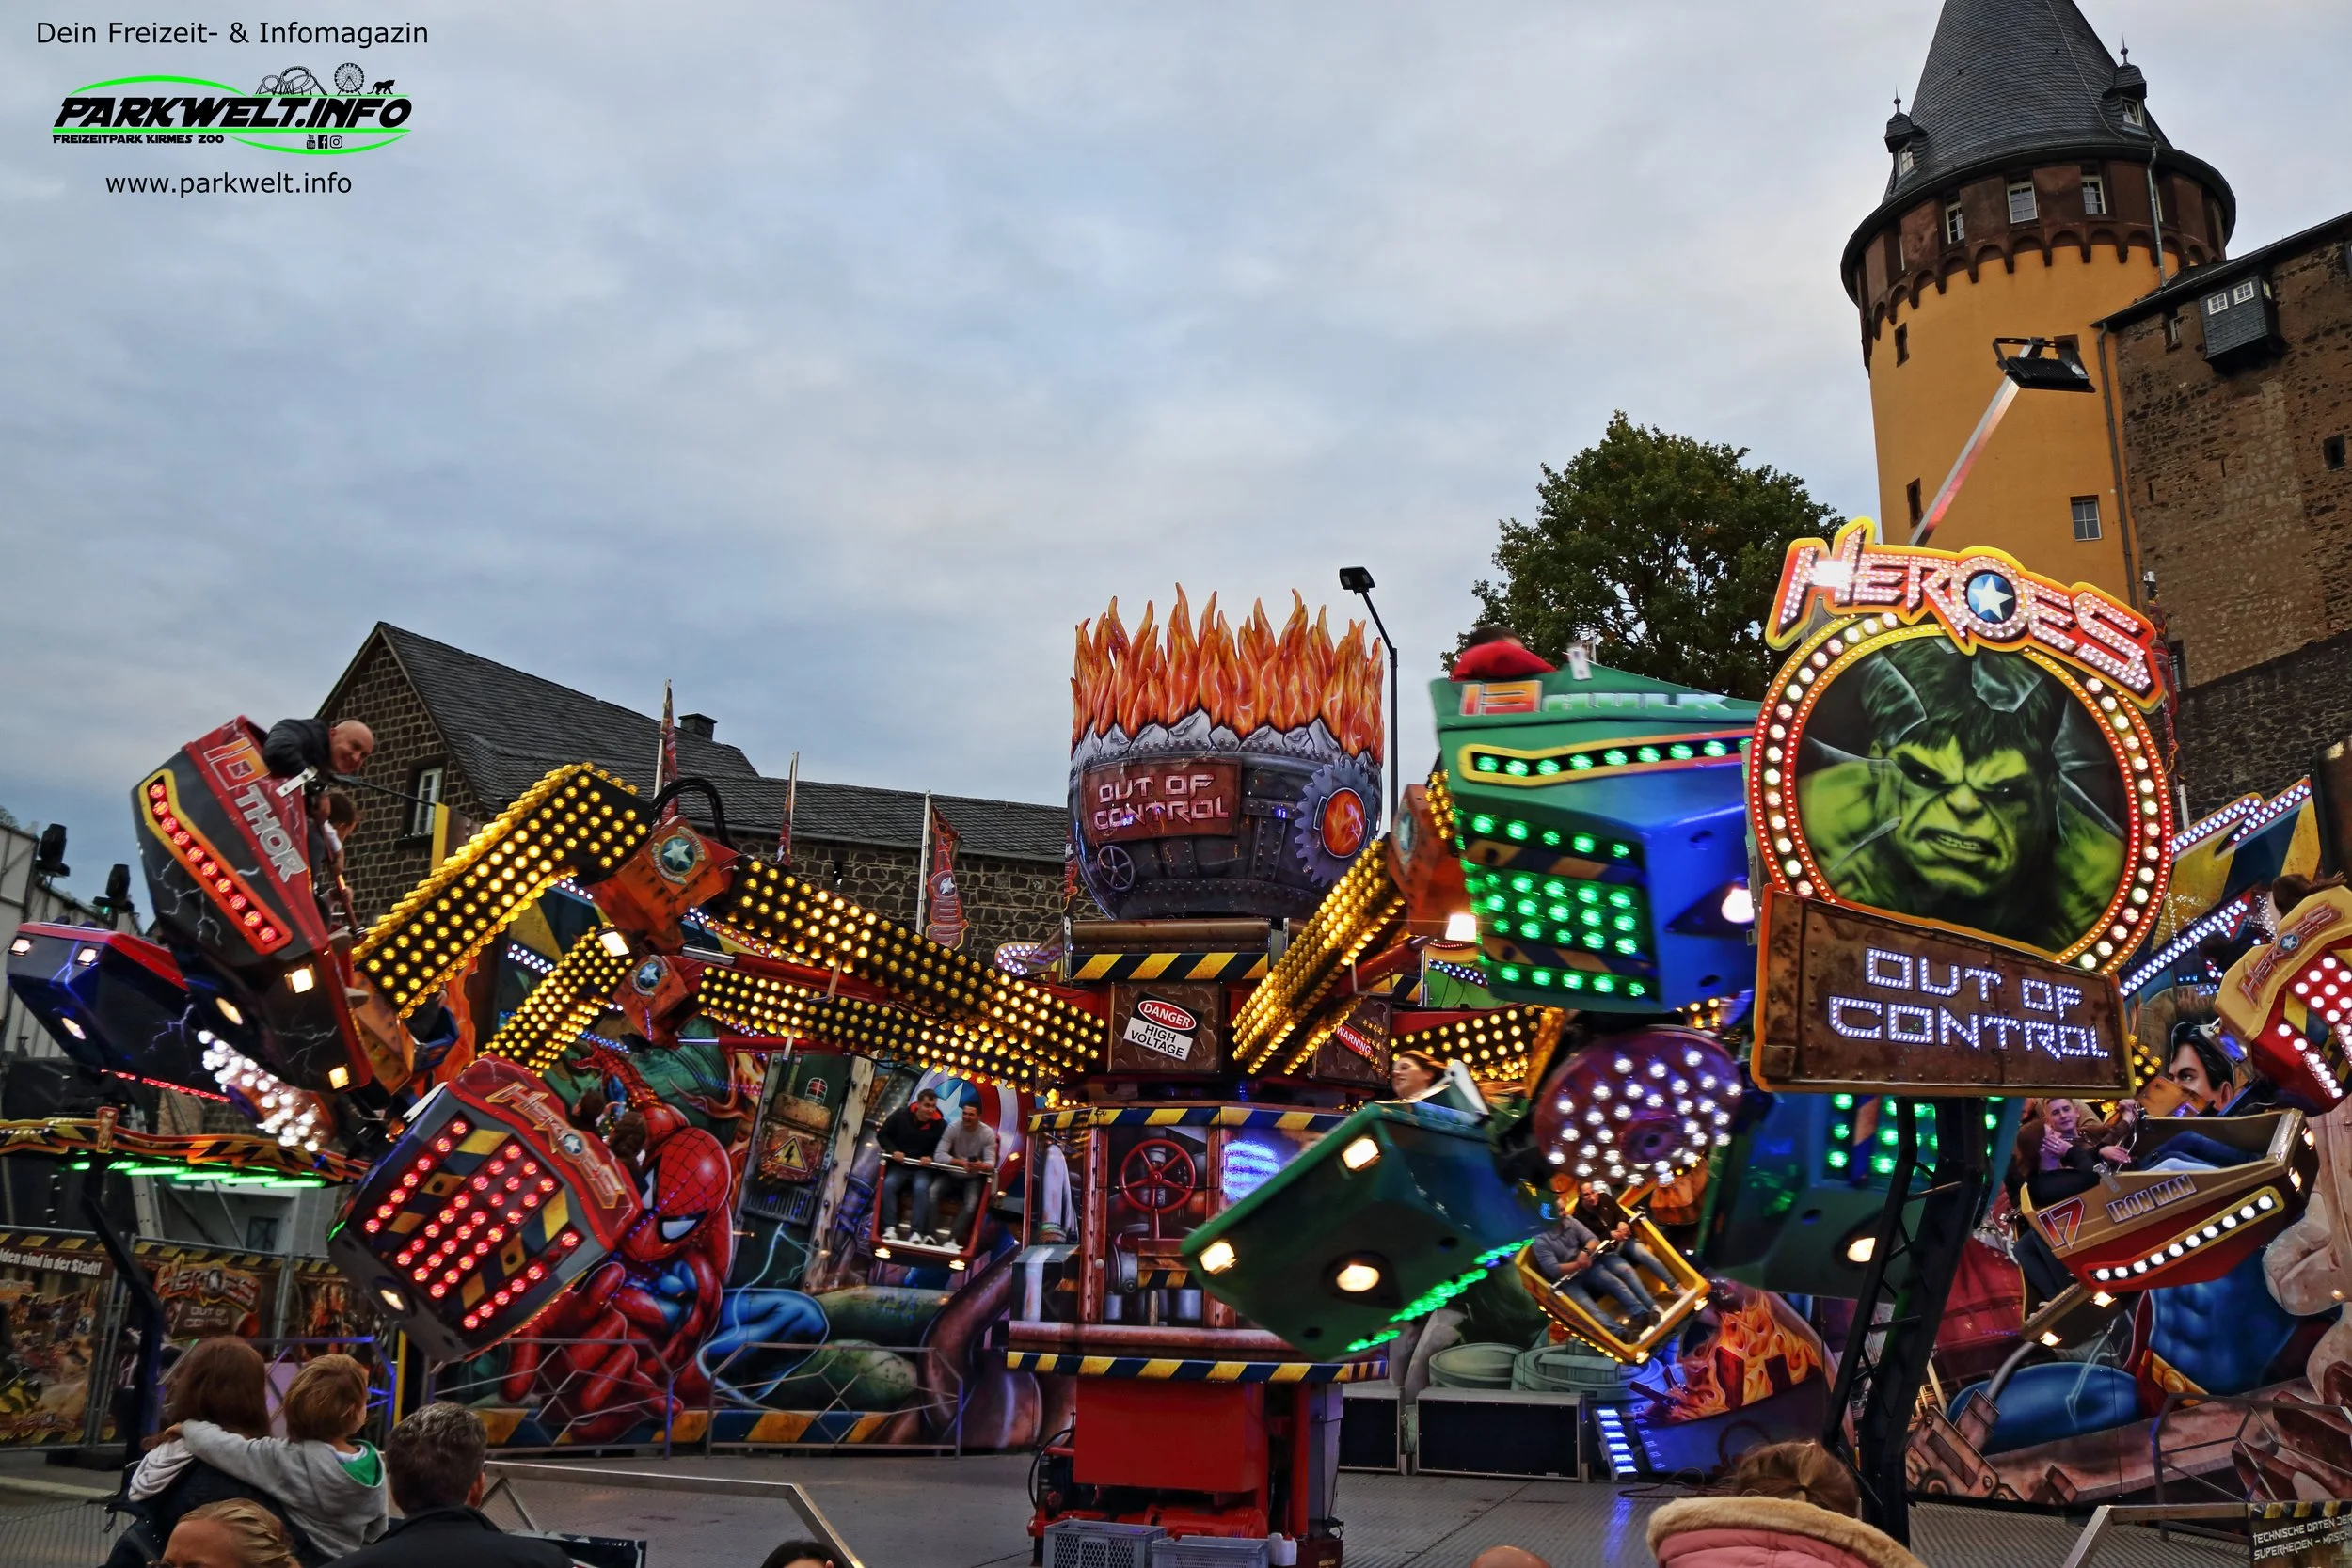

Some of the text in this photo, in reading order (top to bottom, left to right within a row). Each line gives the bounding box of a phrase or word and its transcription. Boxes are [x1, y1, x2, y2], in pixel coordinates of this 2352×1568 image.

[1777, 524, 2156, 699] HEROES
[1459, 679, 1543, 717] 13
[1098, 773, 1216, 804] OUT OF
[203, 736, 307, 883] 10 THOR
[1093, 795, 1230, 826] CONTROL
[2241, 901, 2344, 1011] HEROES
[1865, 946, 2084, 1022] OUT OF
[1143, 1003, 1191, 1028] DANGER
[1828, 995, 2110, 1063] CONTROL
[1131, 1030, 1184, 1057] VOLTAGE
[1144, 1024, 1177, 1043] HIGH
[1337, 1025, 1372, 1054] WARNING
[485, 1082, 625, 1209] HEROES
[2038, 1173, 2198, 1250] 17 IRON MAN
[21, 1252, 44, 1268] sind
[42, 1254, 56, 1269] in
[54, 1256, 71, 1272] der
[71, 1259, 103, 1276] Stadt!
[155, 1256, 256, 1308] HEROES
[191, 1306, 214, 1316] OUT
[2253, 1524, 2305, 1547] TECHNISCHE
[2306, 1517, 2335, 1533] DATEN
